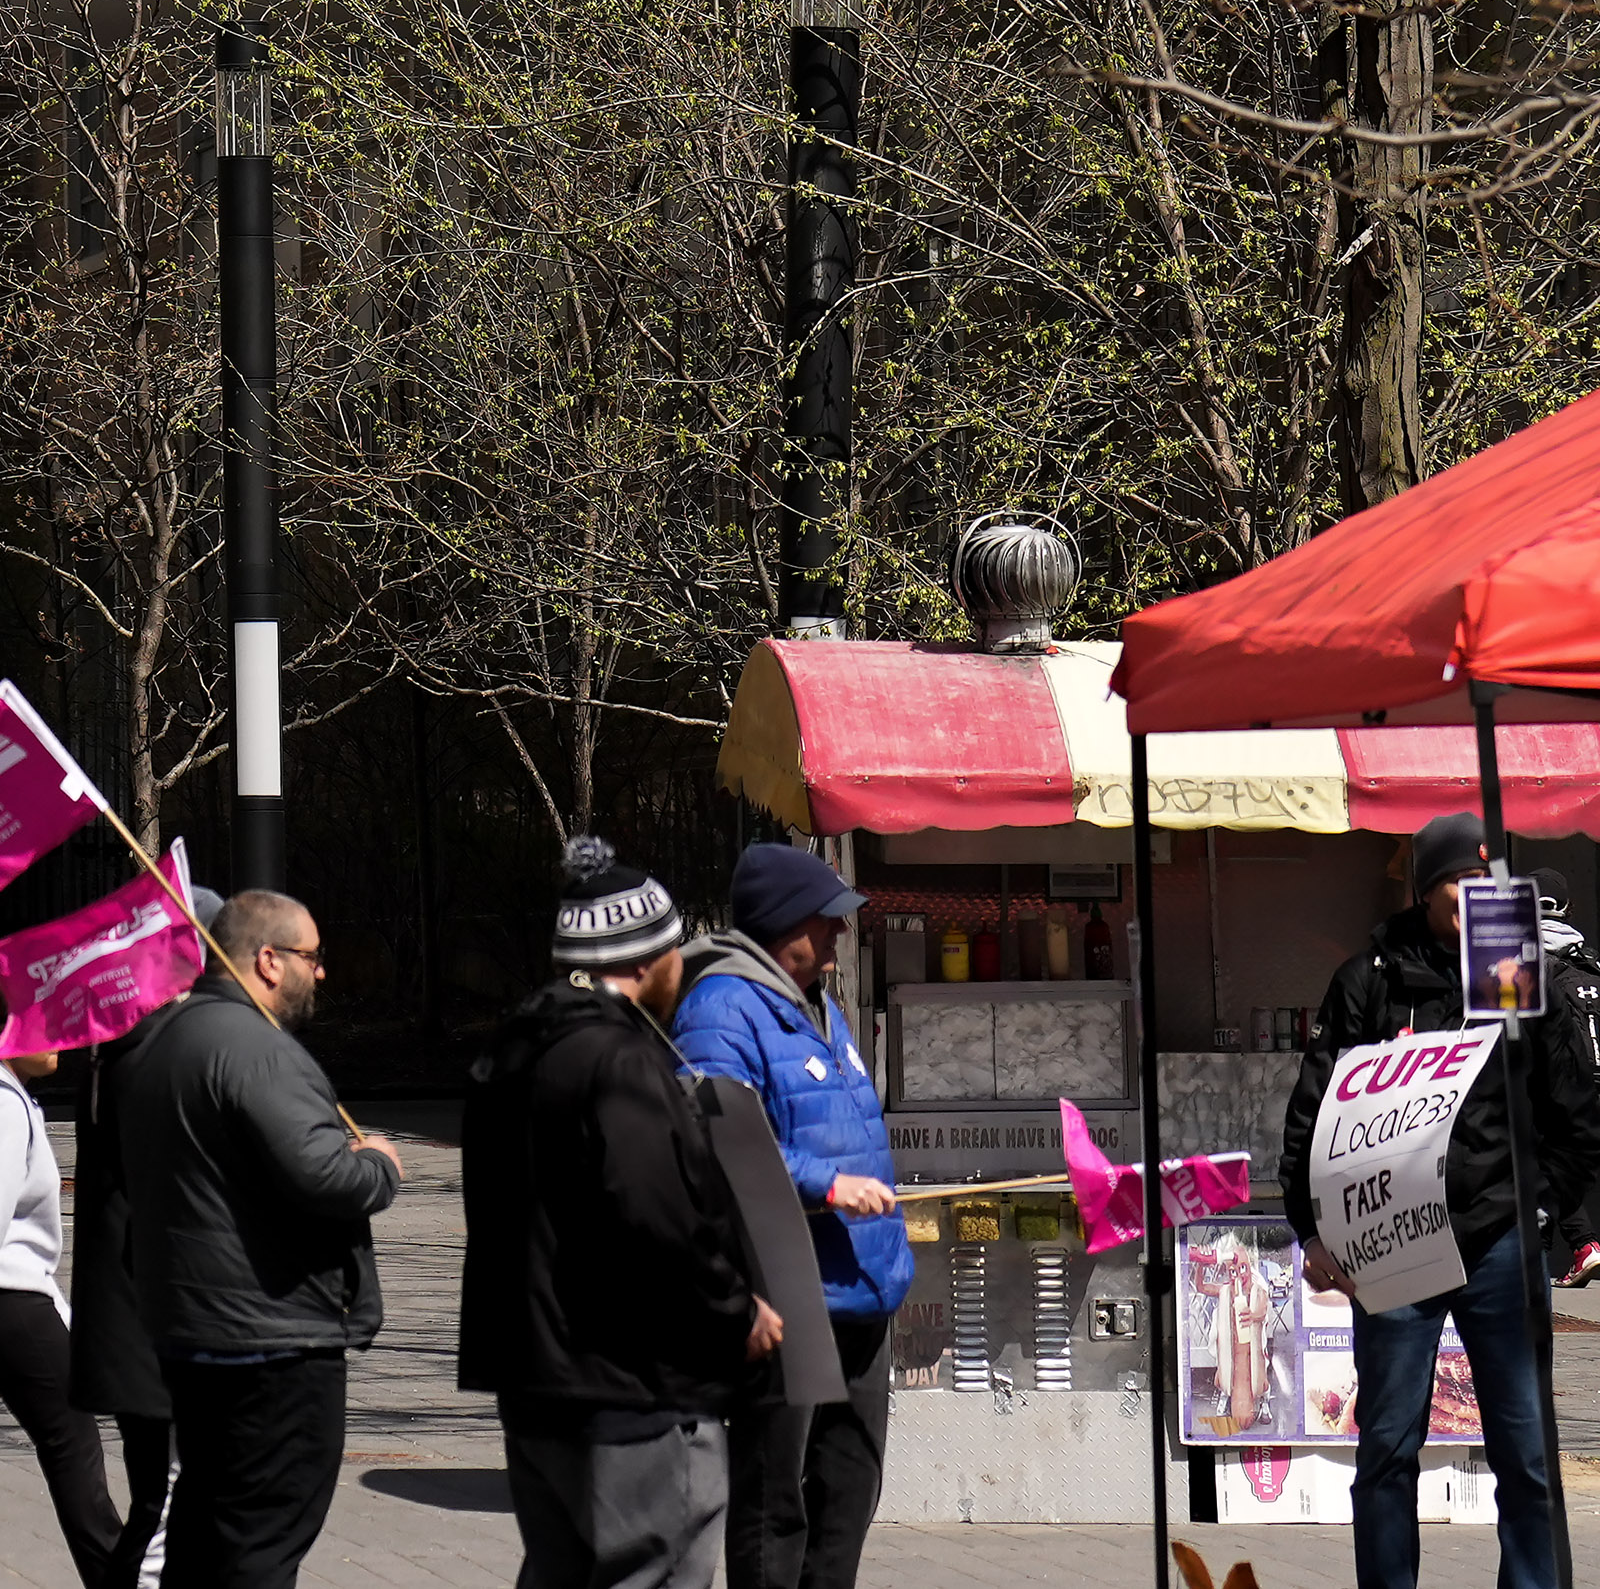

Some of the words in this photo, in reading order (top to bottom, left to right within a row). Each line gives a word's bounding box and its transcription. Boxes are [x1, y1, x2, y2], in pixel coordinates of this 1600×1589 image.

[1335, 1039, 1484, 1103] CUPE
[889, 1127, 930, 1150] HAVE
[934, 1127, 945, 1150] A
[949, 1127, 1001, 1150] BREAK
[1005, 1127, 1046, 1150] HAVE
[1341, 1168, 1393, 1226] FAIR
[1308, 1331, 1350, 1348] German
[1437, 1331, 1464, 1348] olis
